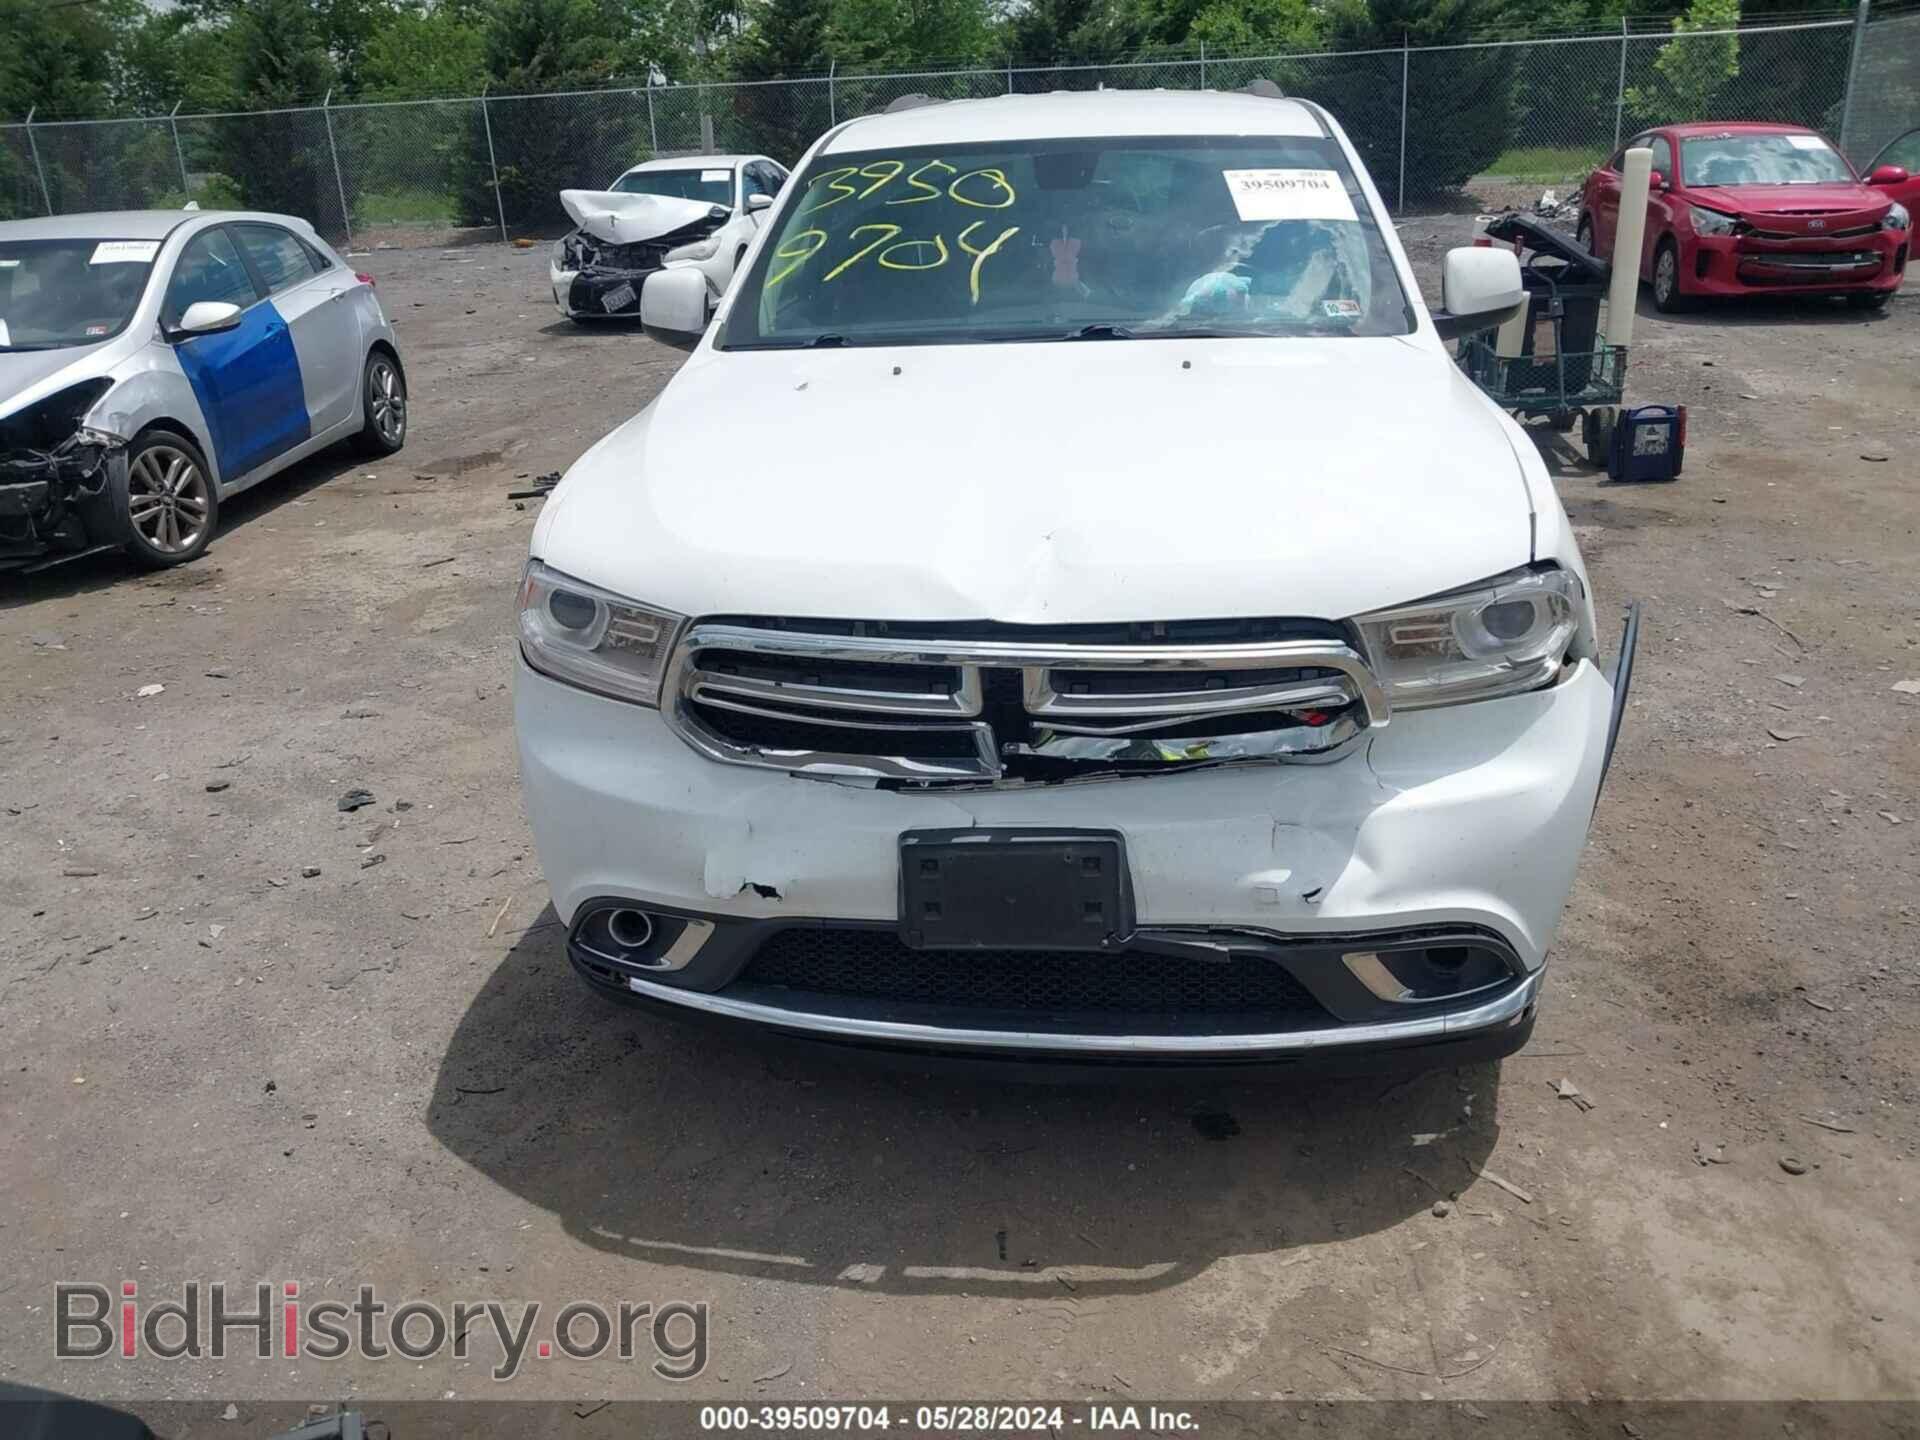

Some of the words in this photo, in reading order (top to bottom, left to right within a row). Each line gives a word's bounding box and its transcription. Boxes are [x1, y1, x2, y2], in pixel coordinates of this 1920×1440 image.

[801, 159, 1016, 215] 3950
[1240, 179, 1331, 190] 39509704
[766, 220, 1020, 305] 9704
